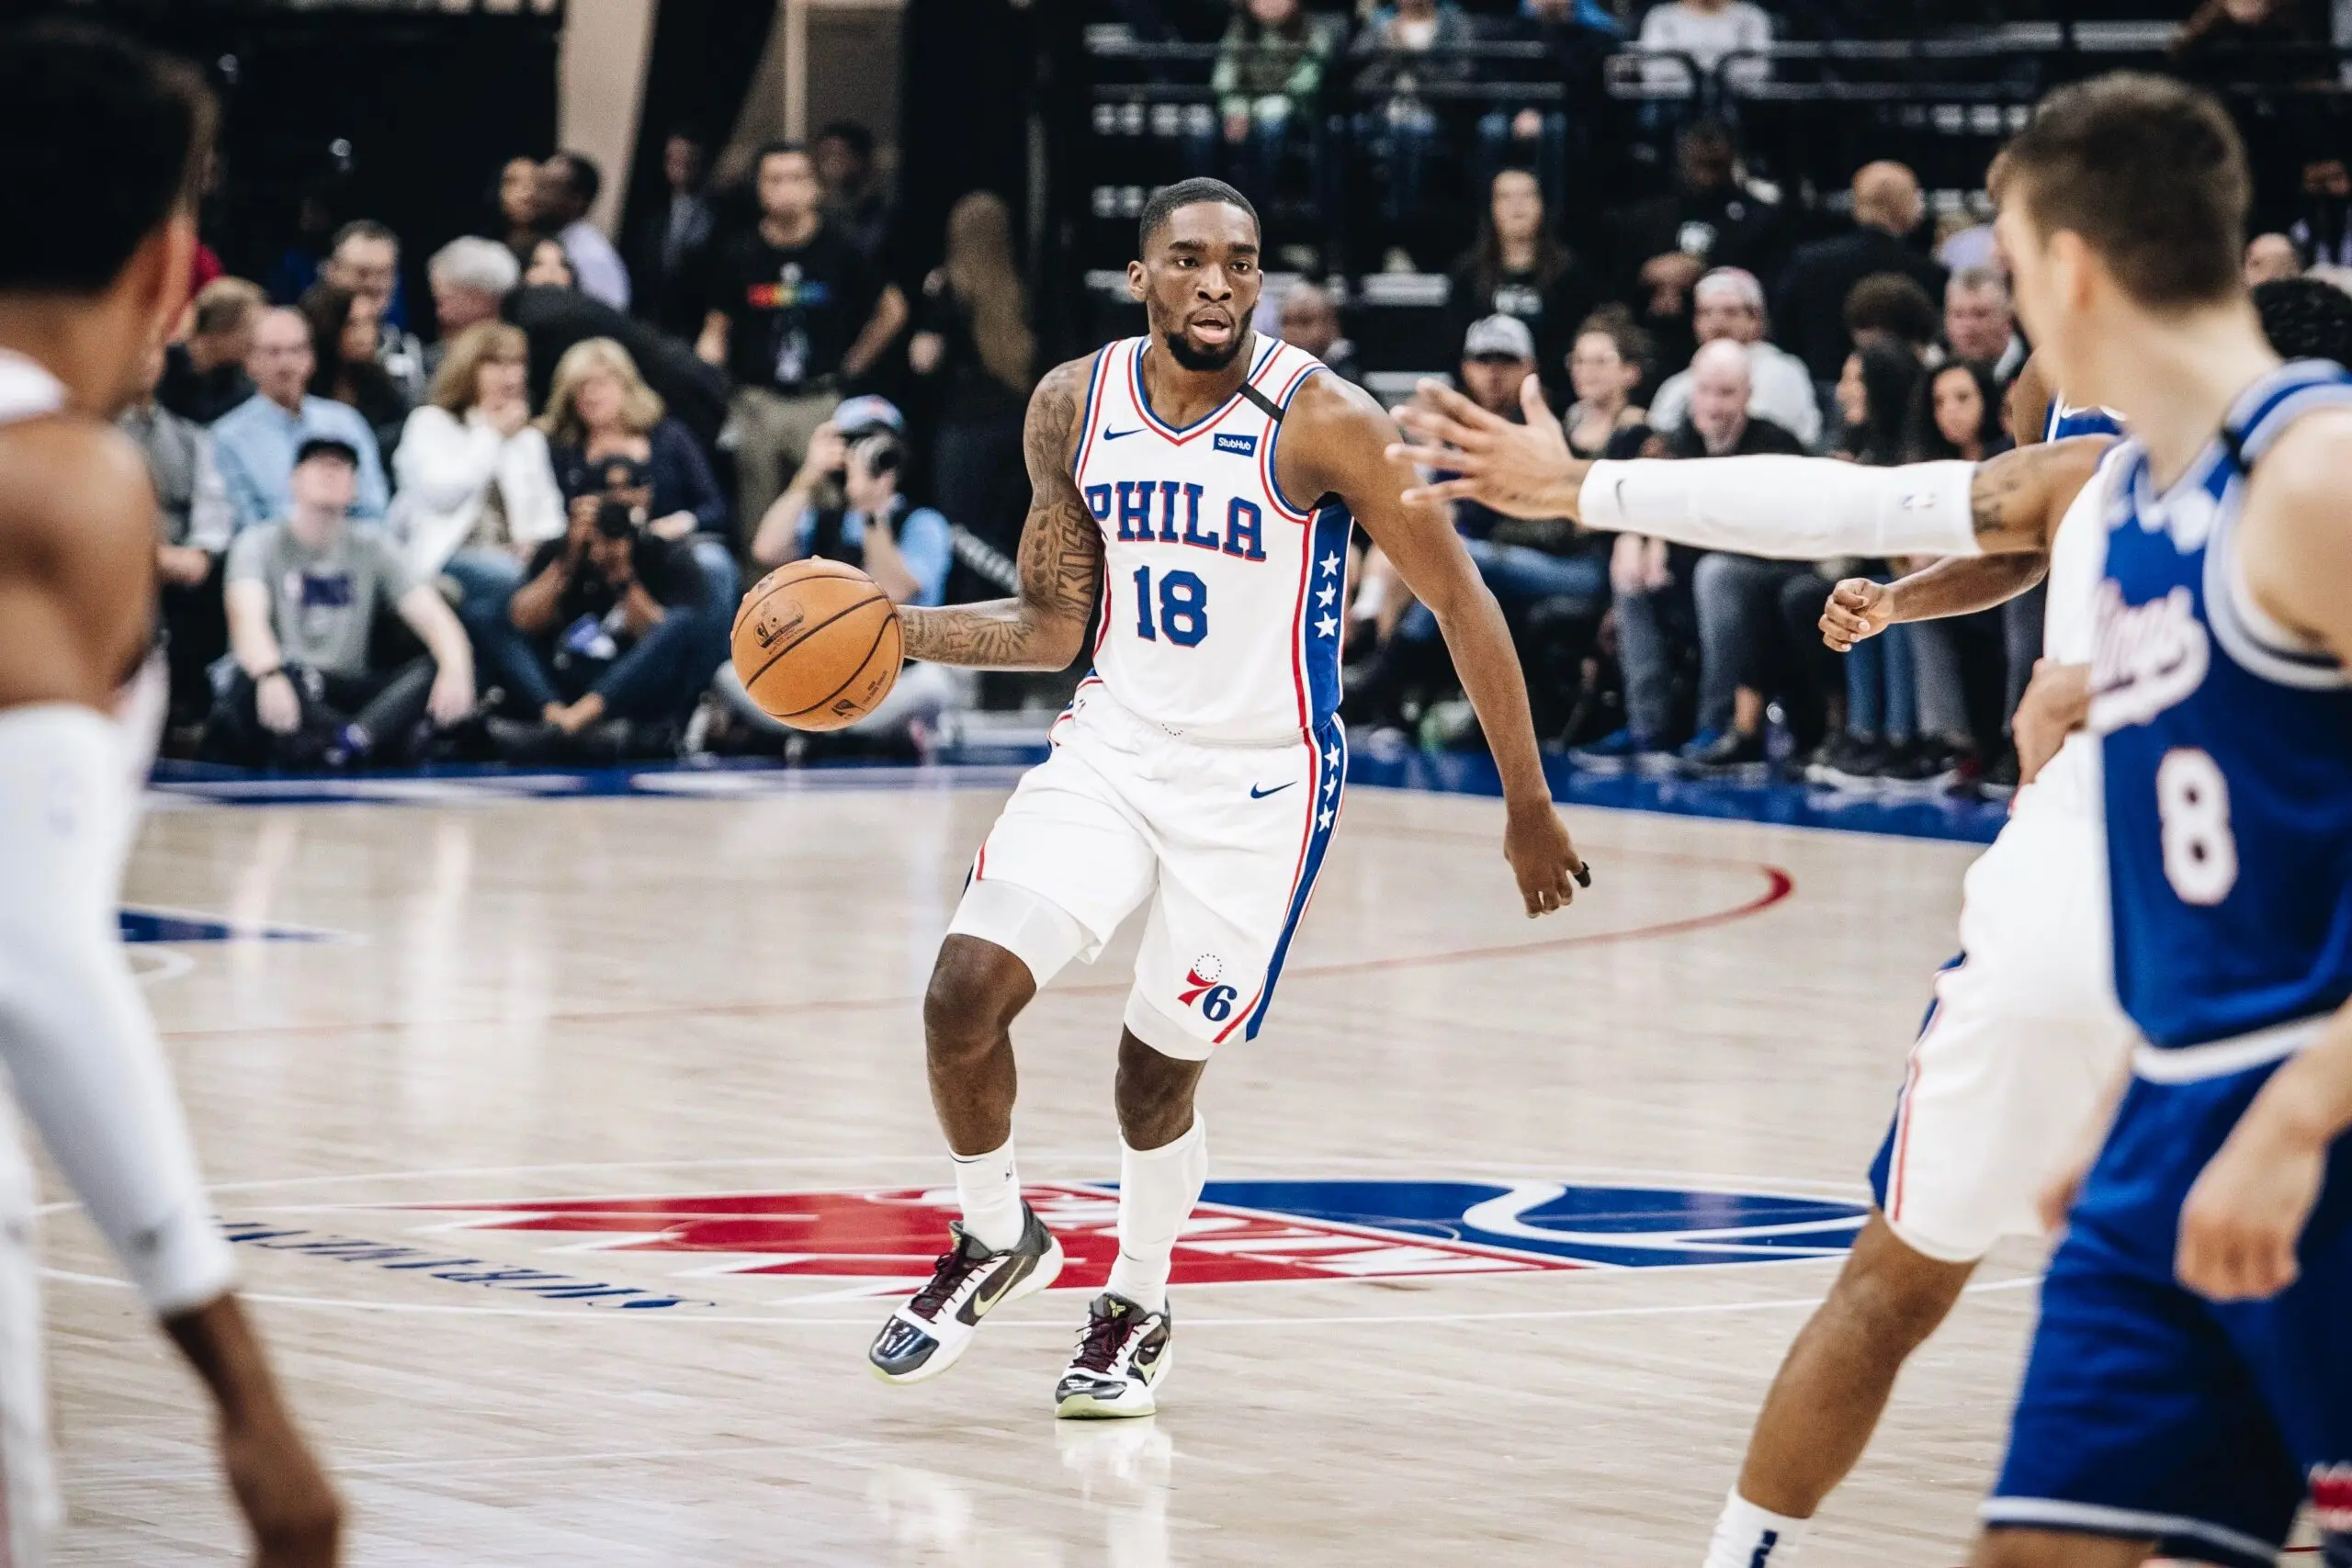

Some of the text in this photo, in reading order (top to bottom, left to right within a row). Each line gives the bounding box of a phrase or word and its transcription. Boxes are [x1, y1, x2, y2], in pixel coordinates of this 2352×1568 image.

[1217, 436, 1251, 451] StubHub
[1085, 480, 1266, 562] PHILA
[1133, 565, 1208, 649] 18
[2155, 746, 2239, 907] 8
[1177, 964, 1238, 1021] 76
